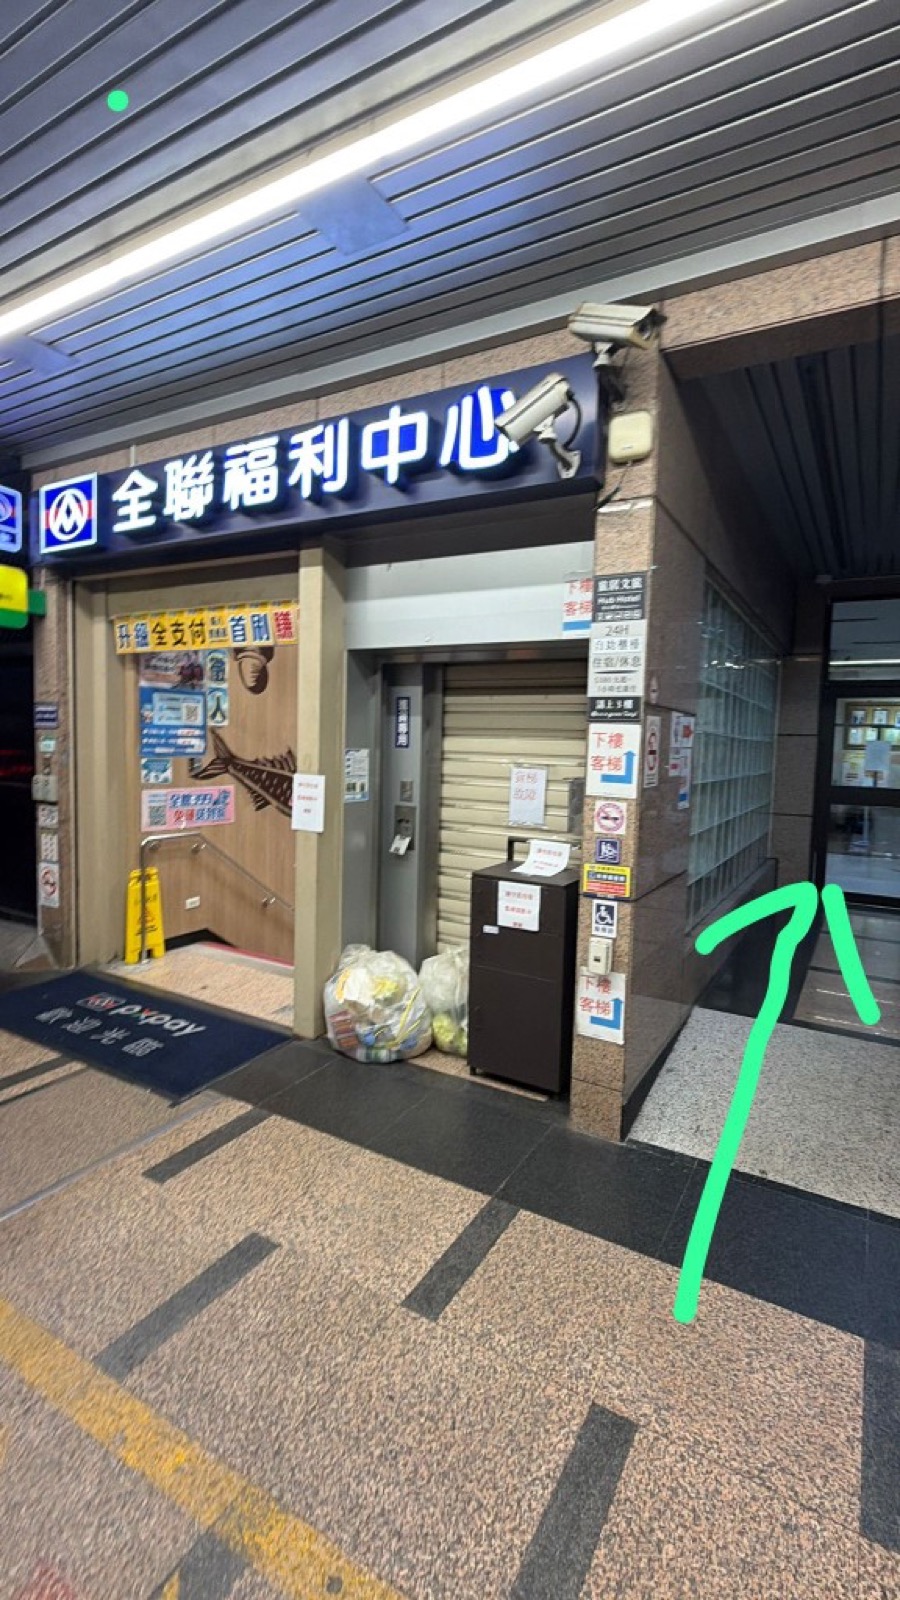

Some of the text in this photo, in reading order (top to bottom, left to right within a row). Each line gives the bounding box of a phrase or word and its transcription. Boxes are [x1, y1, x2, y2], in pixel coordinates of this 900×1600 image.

[111, 385, 519, 534] 全聯福利中心
[117, 617, 206, 649] 升級全支付
[591, 731, 624, 749] 下樓
[590, 755, 623, 771] 客梯
[582, 975, 612, 995] 下樓
[580, 997, 611, 1017] 客梯
